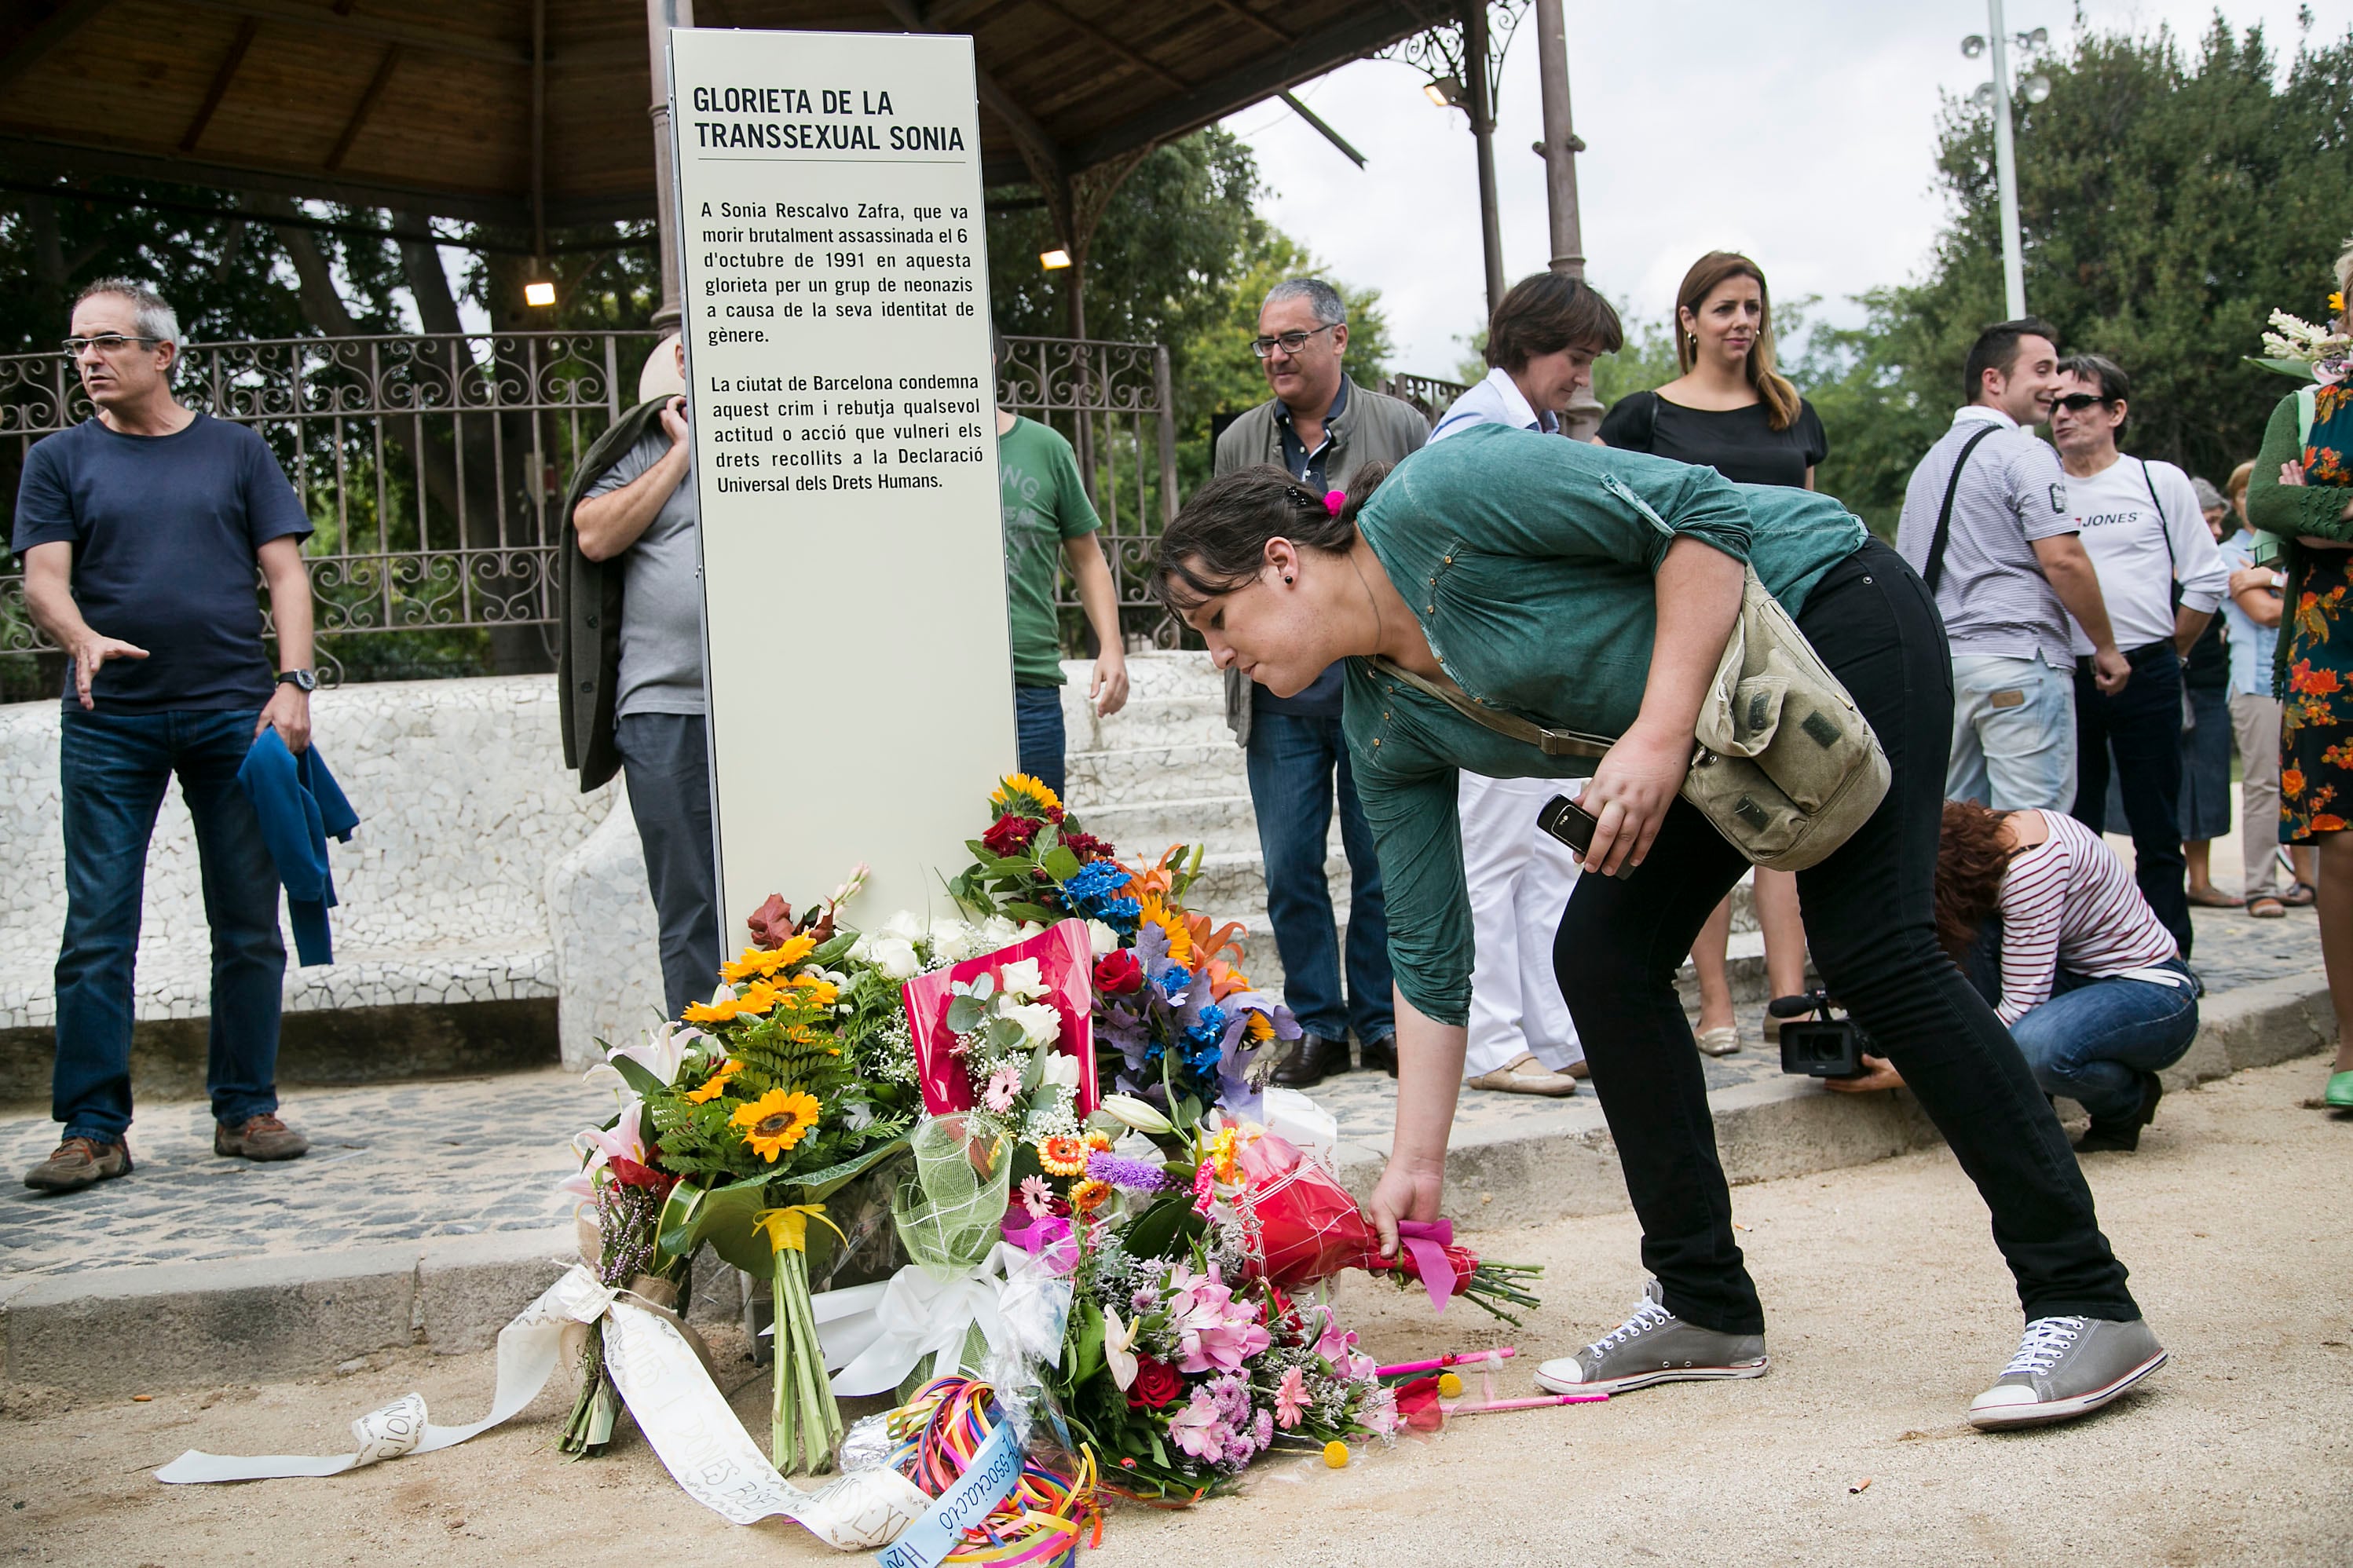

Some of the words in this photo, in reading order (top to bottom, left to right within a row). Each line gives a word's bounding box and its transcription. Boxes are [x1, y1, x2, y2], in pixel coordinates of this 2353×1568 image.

[694, 87, 812, 113] GLORIETA
[822, 90, 852, 114] DE
[863, 91, 893, 115] LA
[694, 122, 880, 149] TRANSSEXUAL
[890, 126, 964, 151] SONIA
[701, 203, 712, 217] A
[722, 202, 766, 217] Sonia
[776, 203, 848, 217] Rescalvo
[858, 203, 903, 221] Zafra,
[914, 207, 941, 222] que
[950, 208, 968, 218] va
[703, 227, 744, 242] morir
[749, 228, 833, 243] brutalment
[839, 228, 933, 243] assassinada
[939, 228, 952, 243] el
[958, 228, 967, 243] 6
[704, 252, 783, 267] d'octubre
[795, 253, 813, 267] de
[826, 252, 863, 267] 1991
[877, 256, 895, 267] en
[906, 254, 970, 271] aquesta
[706, 277, 767, 296] glorieta
[776, 281, 800, 295] per
[809, 281, 826, 292] un
[836, 281, 869, 295] grup
[879, 277, 895, 291] de
[905, 276, 972, 291] neonazis
[708, 306, 715, 317] a
[726, 306, 774, 317] causa
[785, 302, 803, 316] de
[813, 302, 826, 316] la
[836, 305, 872, 316] seva
[882, 302, 947, 316] identitat
[957, 302, 973, 316] de
[709, 327, 768, 345] gènere.
[712, 377, 729, 392] La
[737, 376, 782, 391] ciutat
[789, 376, 807, 390] de
[814, 375, 892, 390] Barcelona
[899, 375, 978, 389] condemna
[713, 403, 769, 420] aquest
[778, 400, 813, 415] crim
[824, 400, 827, 415] i
[838, 399, 894, 418] rebutja
[904, 398, 979, 417] qualsevol
[715, 426, 773, 442] actitud
[783, 429, 791, 440] o
[802, 425, 845, 440] acció
[856, 428, 884, 443] que
[894, 422, 949, 438] vulneri
[959, 423, 981, 437] els
[716, 452, 759, 467] drets
[773, 450, 841, 466] recollits
[854, 453, 862, 464] a
[874, 449, 887, 464] la
[898, 447, 983, 463] Declaració
[718, 477, 789, 492] Universal
[796, 476, 826, 491] dels
[833, 475, 872, 489] Drets
[879, 474, 942, 488] Humans.
[2083, 512, 2138, 527] JONES
[939, 1432, 1020, 1537] Associació
